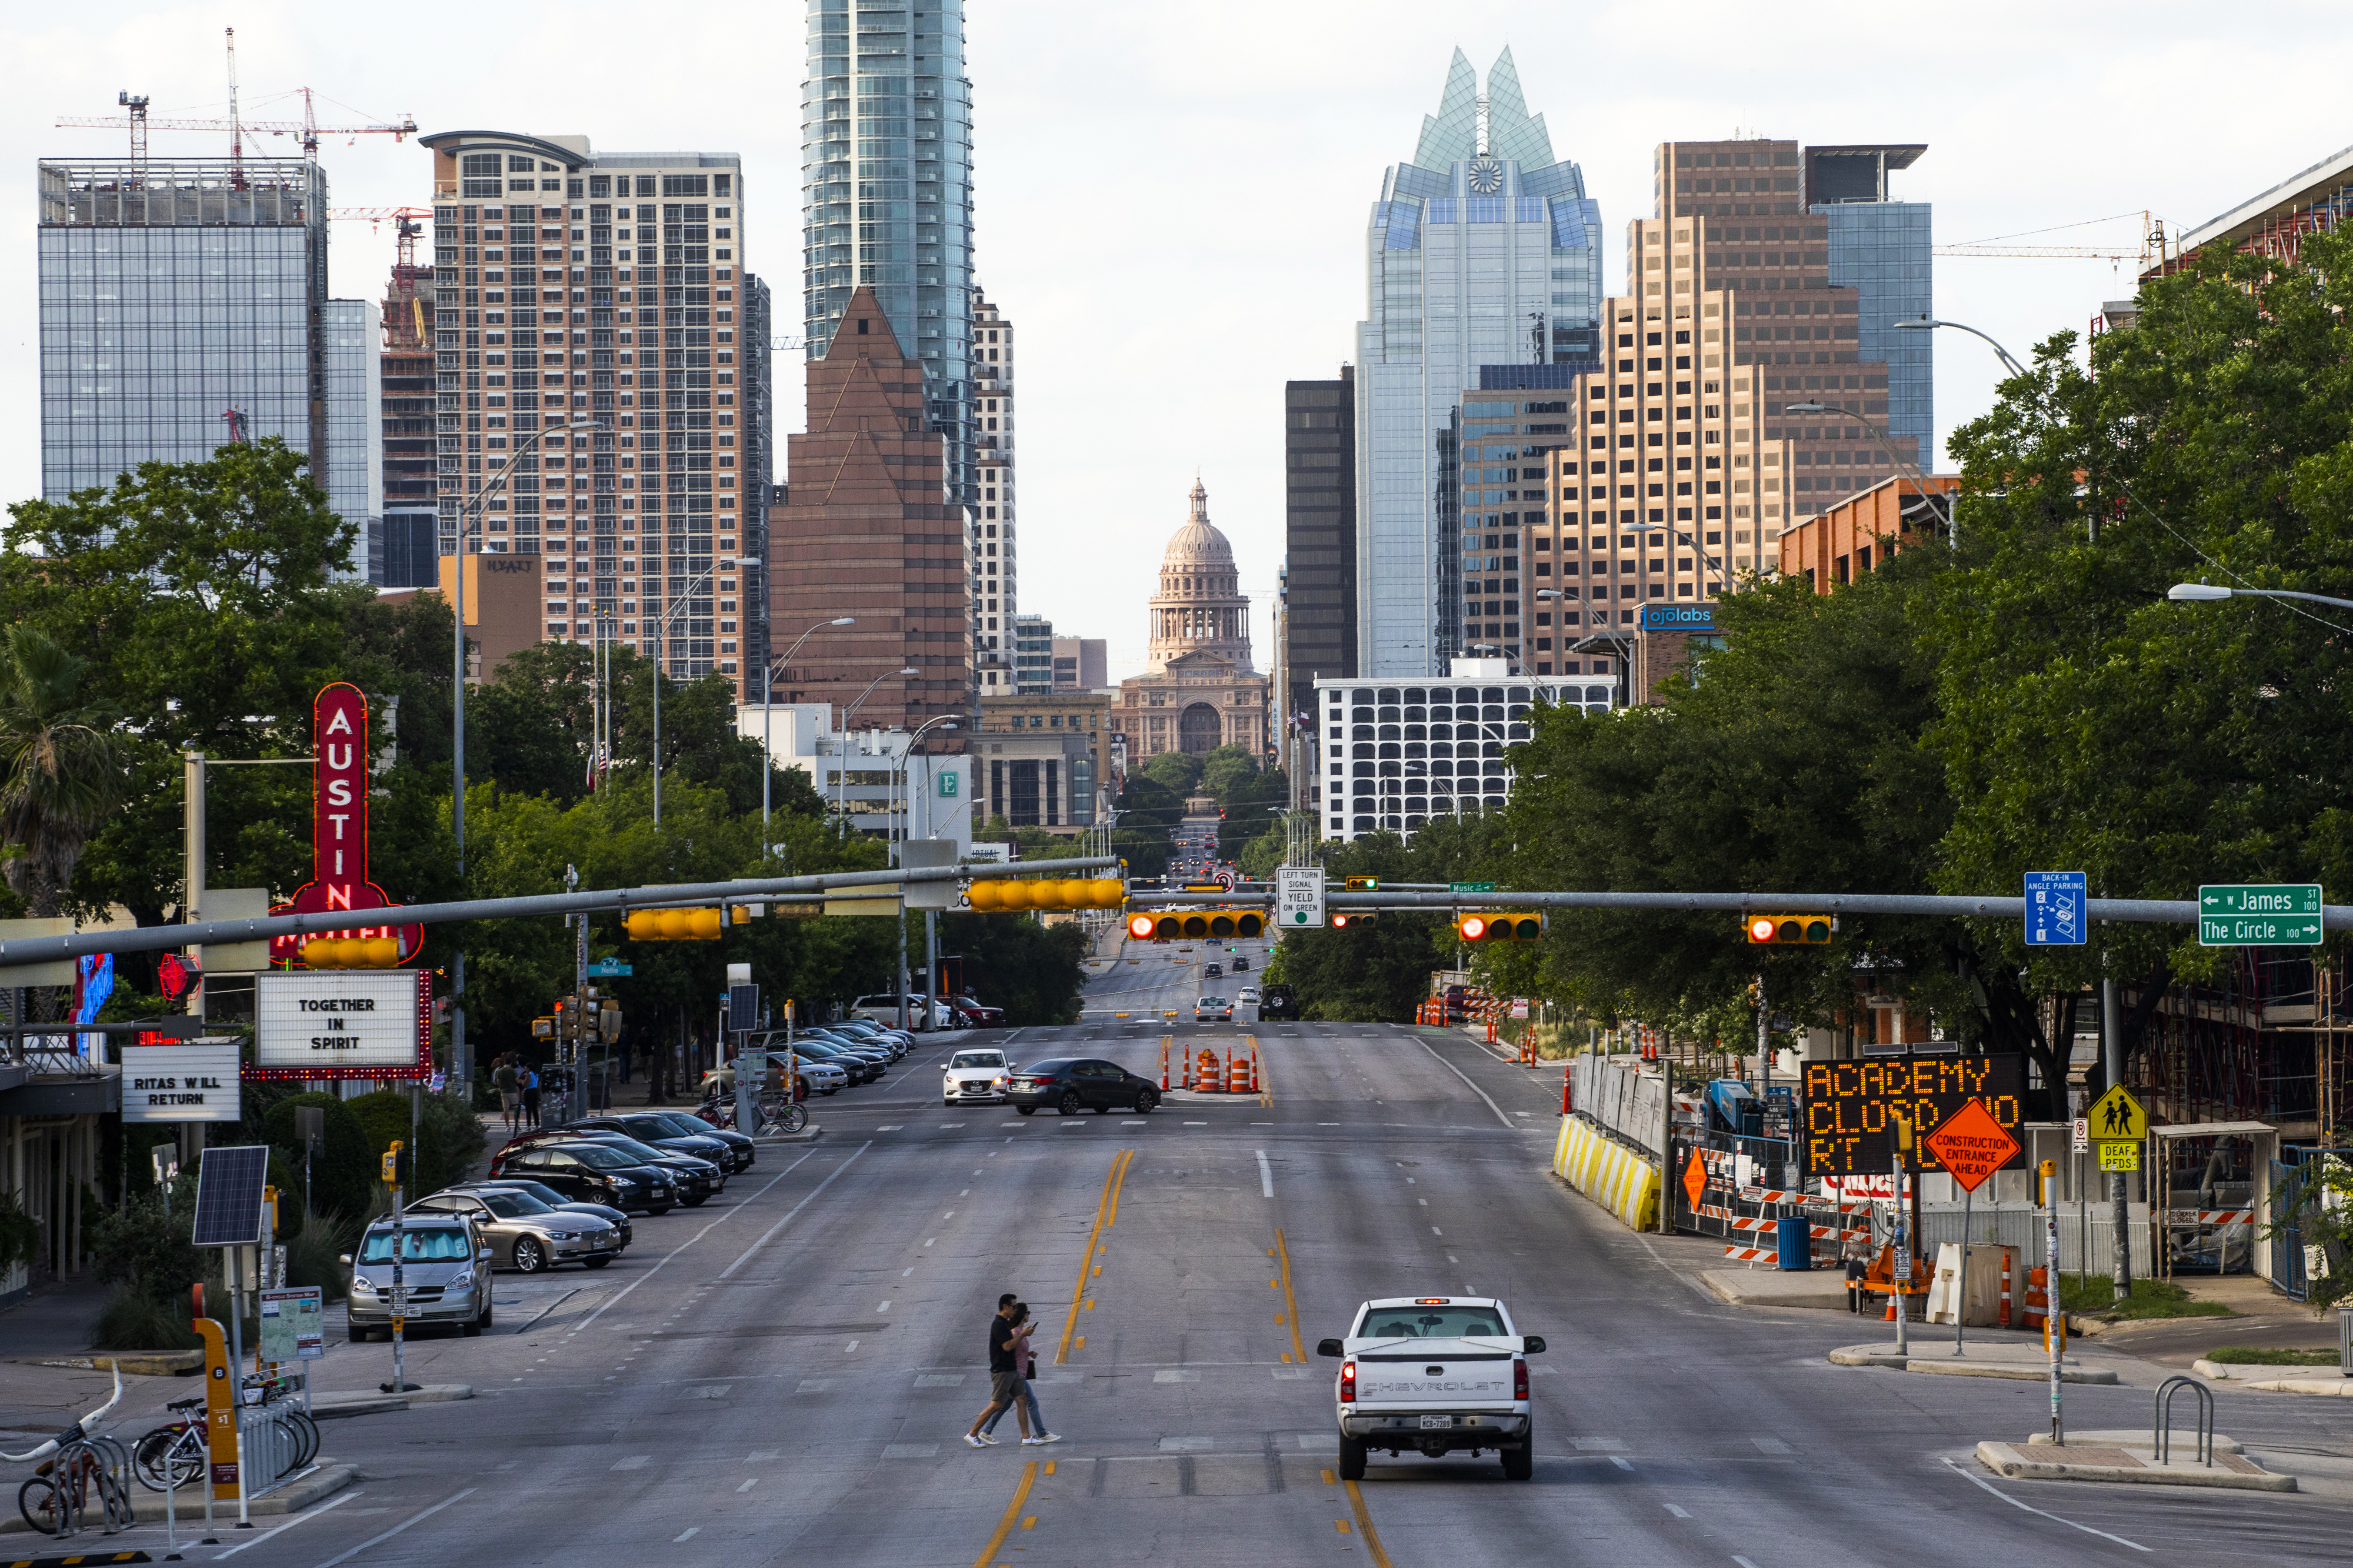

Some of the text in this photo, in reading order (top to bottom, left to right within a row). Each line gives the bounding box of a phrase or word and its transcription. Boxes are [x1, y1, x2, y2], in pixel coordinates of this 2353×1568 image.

[488, 561, 532, 573] HYATT
[325, 708, 353, 910] AUSTIN
[1288, 893, 1313, 902] YIELD
[2227, 889, 2317, 910] W James ST
[2304, 901, 2317, 910] 100
[2204, 921, 2299, 939] The Circle 100
[299, 999, 375, 1012] TOGETHER
[328, 1018, 344, 1030] IN
[311, 1037, 359, 1049] SPIRIT
[134, 1077, 221, 1089] RITAS WILL
[1808, 1059, 1989, 1097] ACADEMY
[149, 1093, 204, 1105] RETURN
[1937, 1135, 2009, 1150] CONSTRUCTION
[1810, 1137, 1860, 1171] RT
[1946, 1149, 1997, 1162] ENTRANCE
[2106, 1146, 2131, 1156] DEAF
[1954, 1163, 1988, 1175] AHEAD
[2106, 1159, 2131, 1168] PEDS
[1364, 1382, 1504, 1392] CHEVROLET
[218, 1414, 228, 1424] $1
[176, 1447, 205, 1459] Electric
